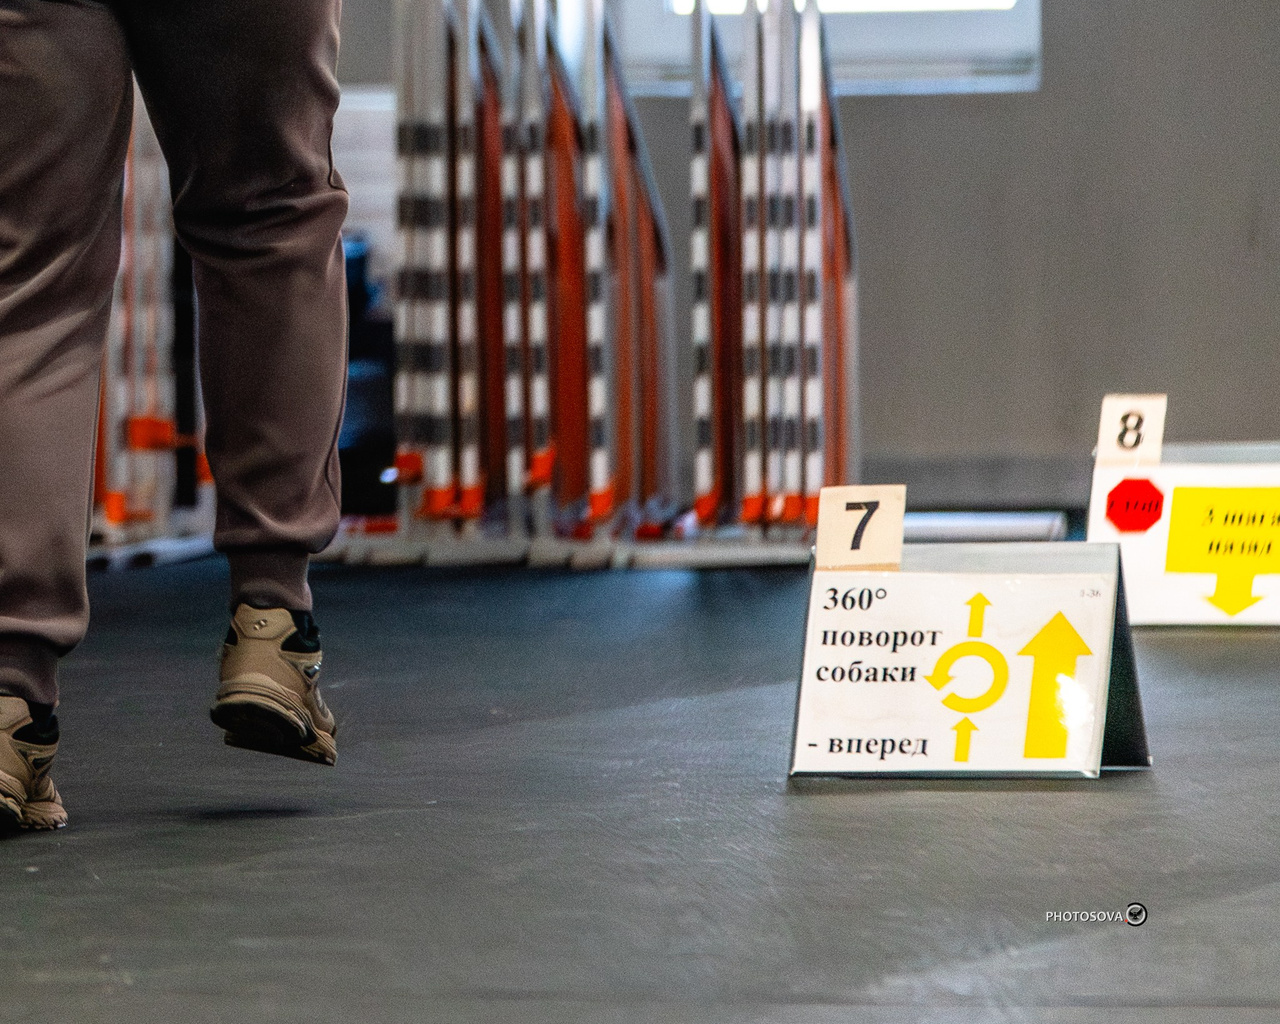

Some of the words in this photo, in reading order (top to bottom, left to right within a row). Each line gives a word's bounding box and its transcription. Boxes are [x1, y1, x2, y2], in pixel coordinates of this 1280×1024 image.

[1117, 411, 1144, 450] 8
[845, 501, 880, 551] 7
[823, 587, 887, 611] 360°
[821, 630, 942, 653] поворот
[816, 661, 917, 683] собаки
[828, 738, 928, 760] вперед
